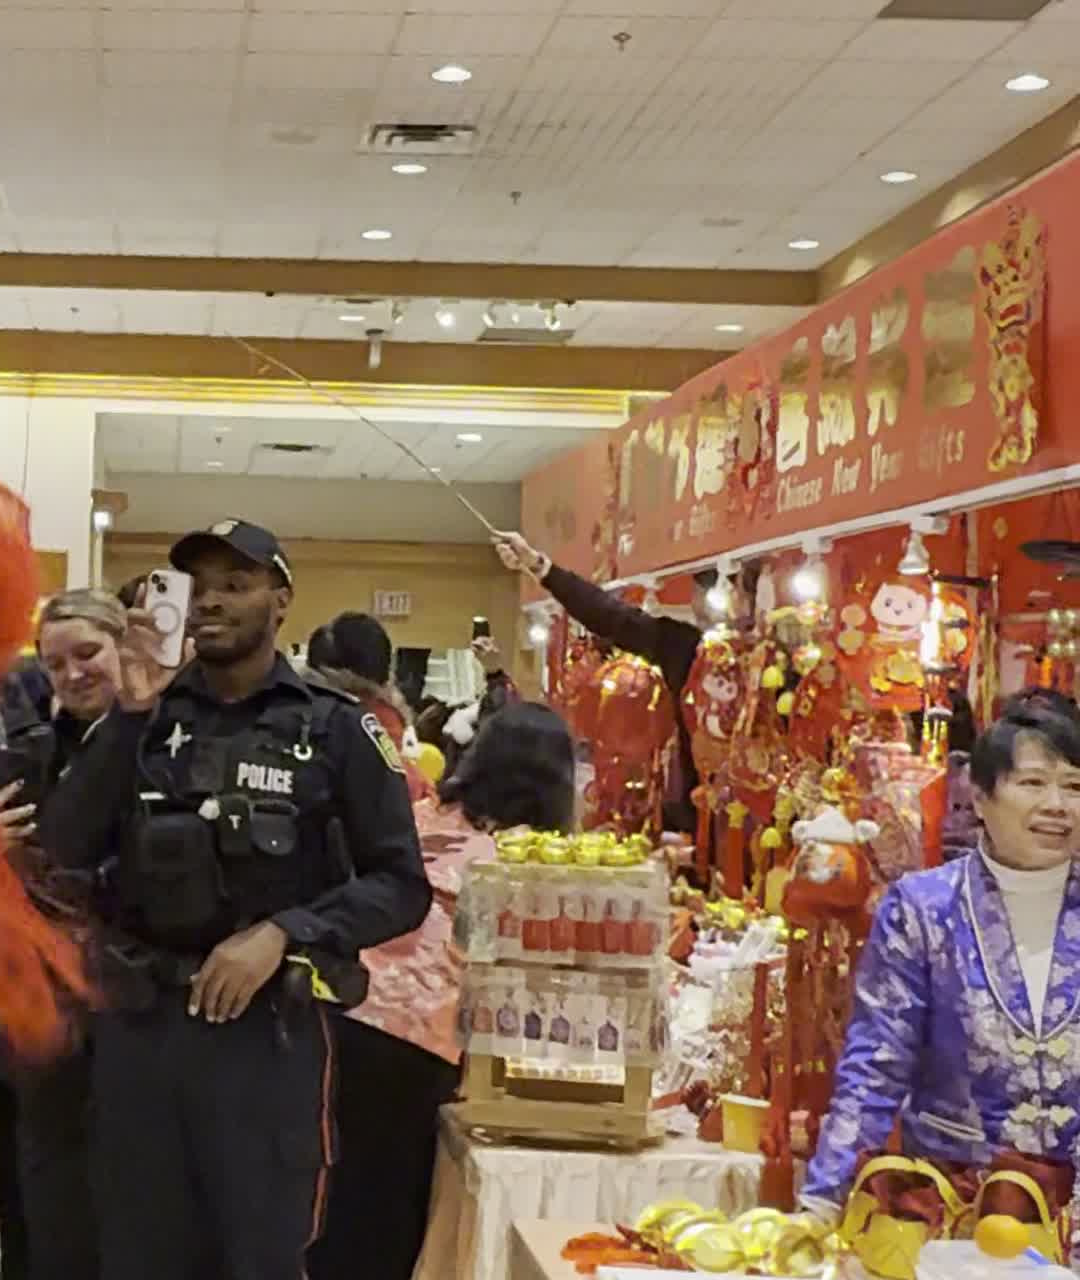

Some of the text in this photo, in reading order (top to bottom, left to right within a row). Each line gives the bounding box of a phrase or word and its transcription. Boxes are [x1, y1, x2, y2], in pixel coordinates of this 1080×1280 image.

[777, 474, 823, 512] Chinese
[831, 455, 862, 497] New
[236, 762, 294, 795] POLICE
